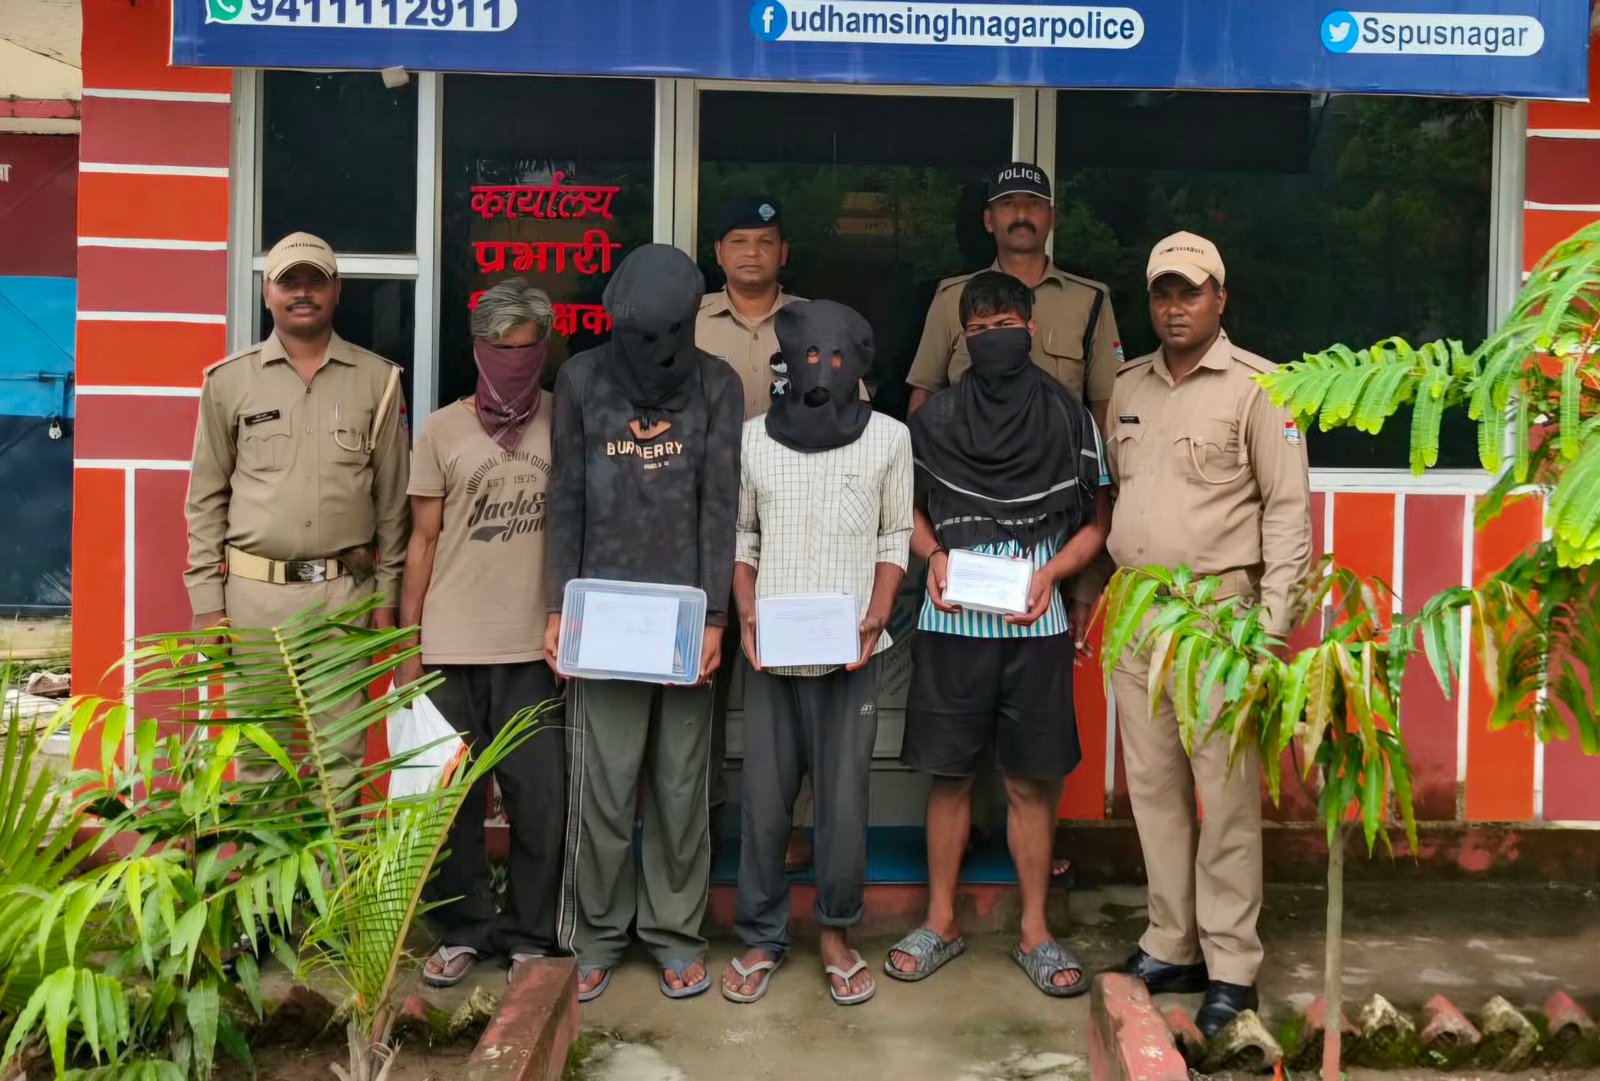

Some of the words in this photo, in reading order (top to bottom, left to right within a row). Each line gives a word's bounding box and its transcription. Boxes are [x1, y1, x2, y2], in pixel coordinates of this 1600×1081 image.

[250, 0, 501, 28] 9411112911
[790, 6, 1136, 45] udhamsinghnagarpolice
[1361, 16, 1529, 53] Sspusnagar
[998, 167, 1042, 184] POLICE
[472, 229, 622, 274] प्रभारी
